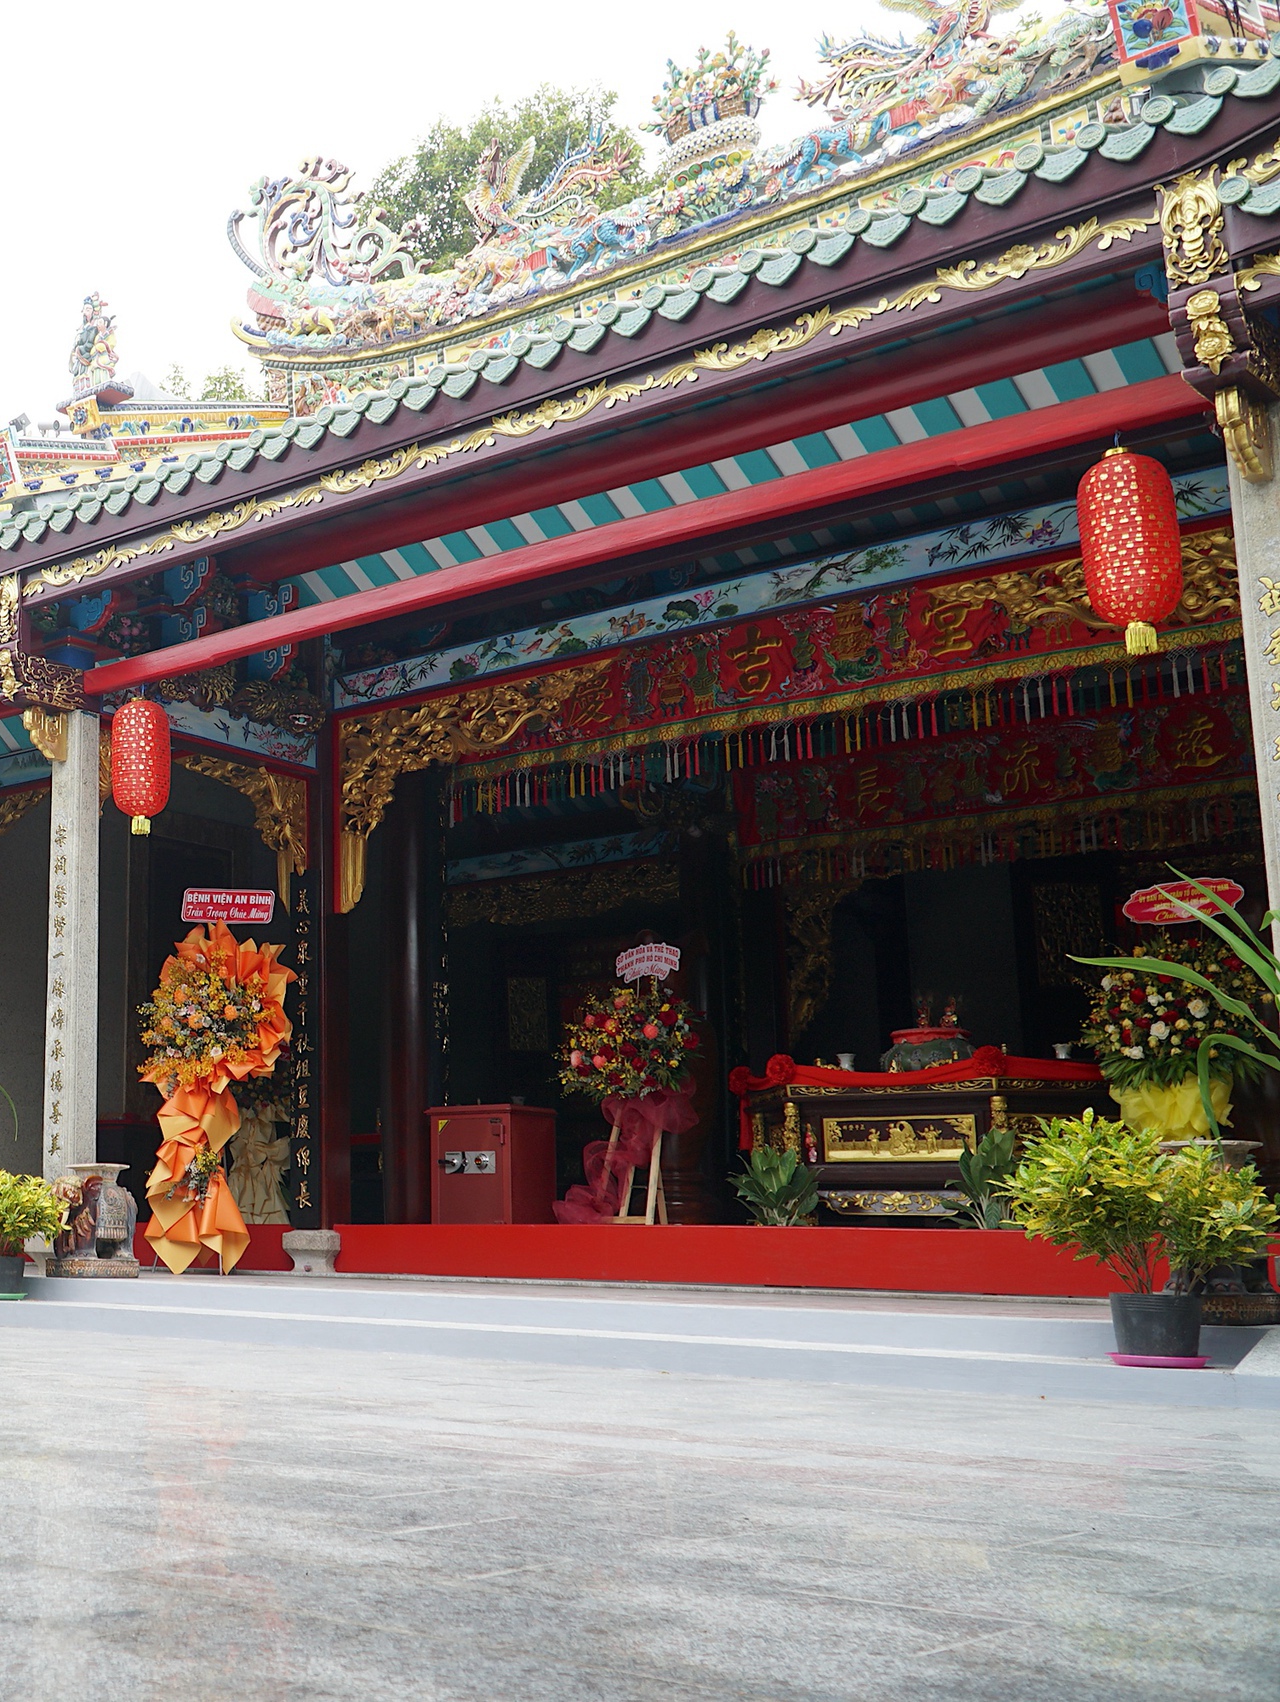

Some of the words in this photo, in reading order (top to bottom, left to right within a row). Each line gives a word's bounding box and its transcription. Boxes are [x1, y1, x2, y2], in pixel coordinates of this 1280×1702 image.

[187, 892, 211, 904] BỆNH
[212, 892, 233, 905] VIỆN
[234, 895, 248, 904] AN
[249, 894, 271, 905] BÌNH
[206, 906, 228, 920] Trọng
[229, 906, 247, 919] Chúc
[247, 908, 269, 921] Mừng
[664, 956, 678, 969] MINH
